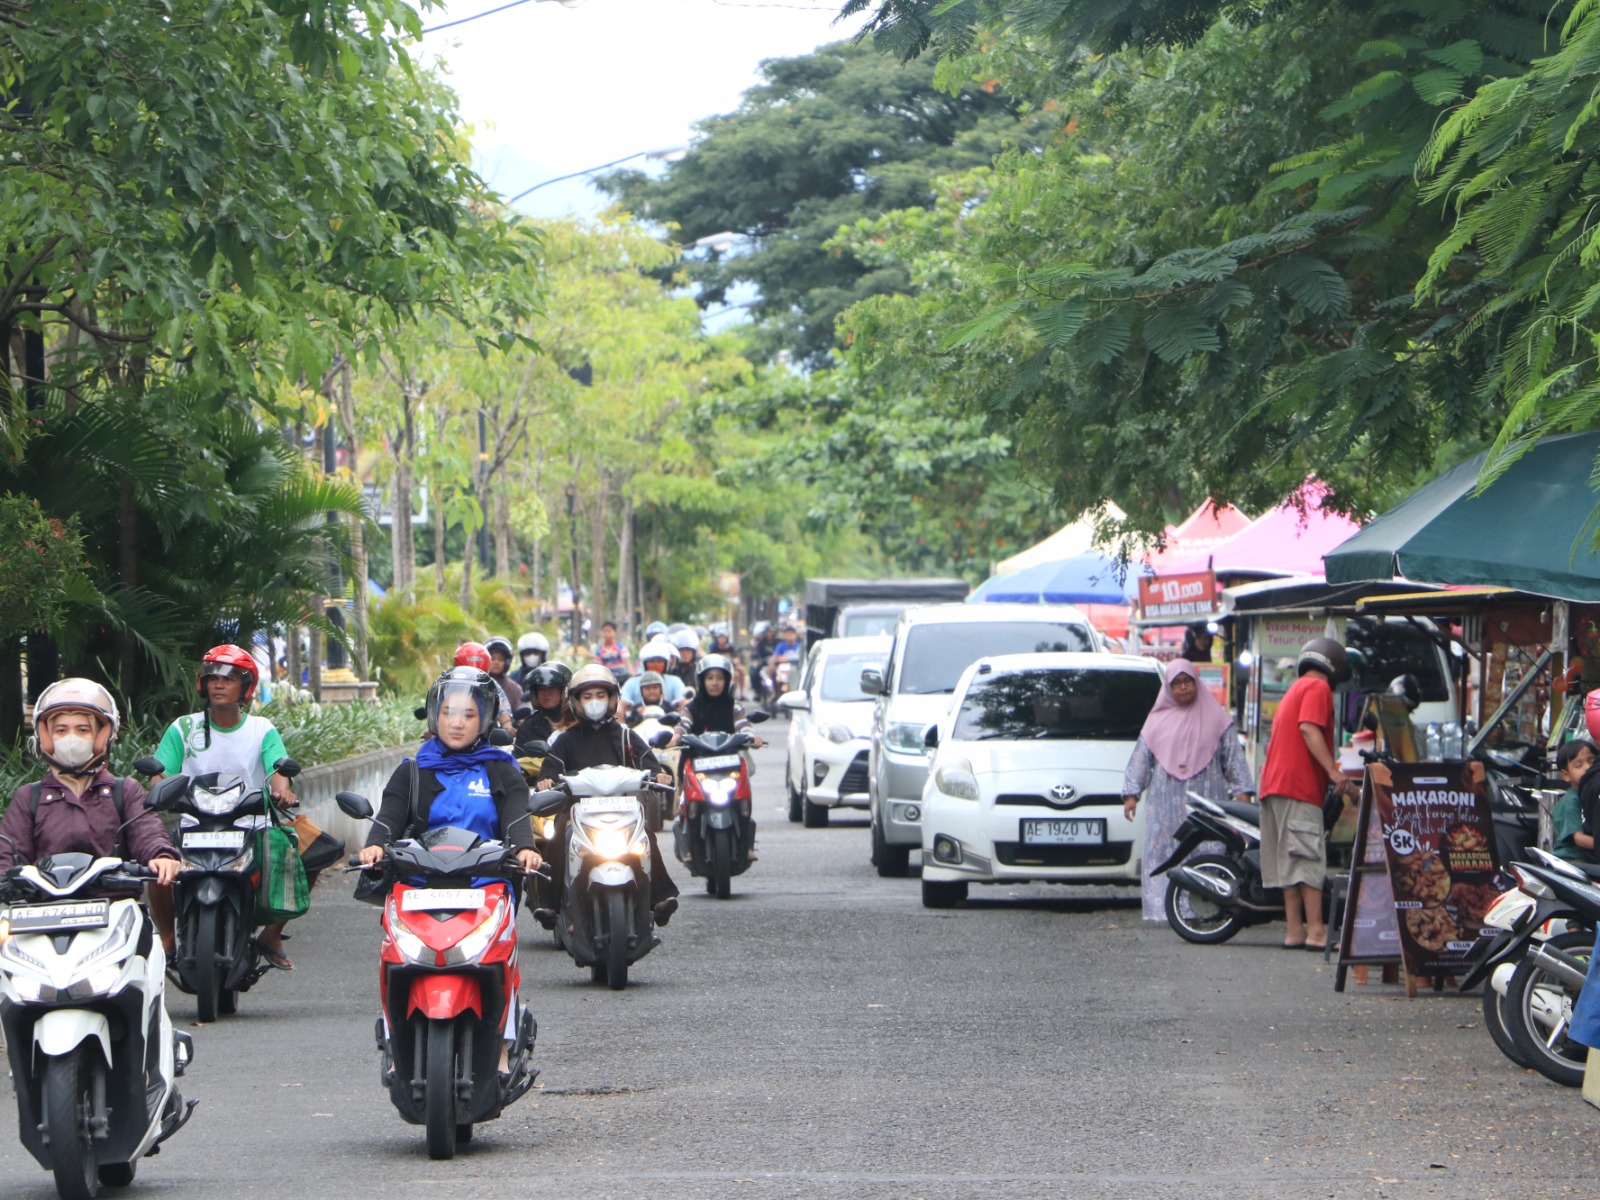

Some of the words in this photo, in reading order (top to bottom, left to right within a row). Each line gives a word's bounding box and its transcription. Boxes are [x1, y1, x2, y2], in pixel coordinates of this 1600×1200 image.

[1269, 634, 1295, 645] Telur
[1391, 790, 1475, 807] MAKARONI
[1026, 822, 1042, 836] AE
[1047, 822, 1079, 836] 1940
[1085, 822, 1102, 836] VJ
[1393, 834, 1413, 849] 5K
[1449, 852, 1491, 860] MAKARONI
[405, 891, 421, 900] AE
